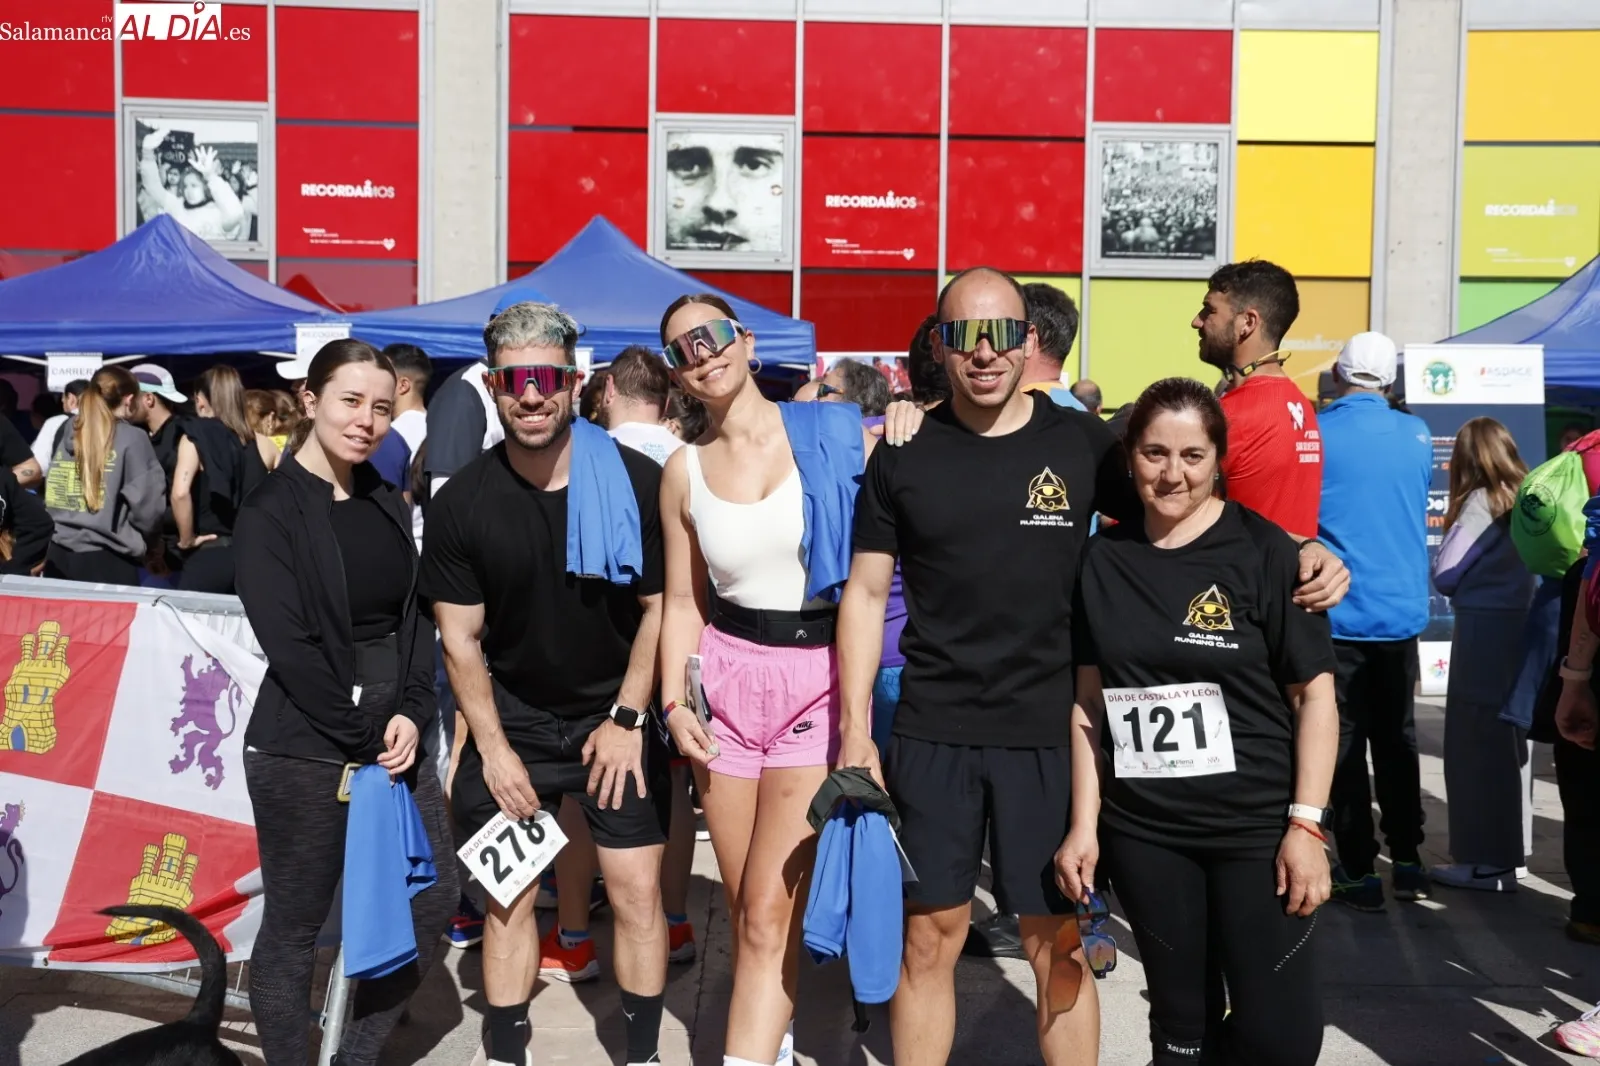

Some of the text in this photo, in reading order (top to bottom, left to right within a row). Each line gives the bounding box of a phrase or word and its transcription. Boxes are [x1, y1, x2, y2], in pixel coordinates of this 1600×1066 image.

[1174, 636, 1239, 649] RUNNING CLUB
[1188, 632, 1224, 642] GALENA
[1108, 693, 1124, 702] DÍA
[1125, 694, 1137, 702] DE
[1183, 690, 1190, 698] Y
[1192, 687, 1220, 697] LEÓN
[1122, 702, 1208, 753] 121
[473, 838, 484, 849] DE
[483, 816, 509, 840] CASTILL
[479, 818, 546, 885] 278
